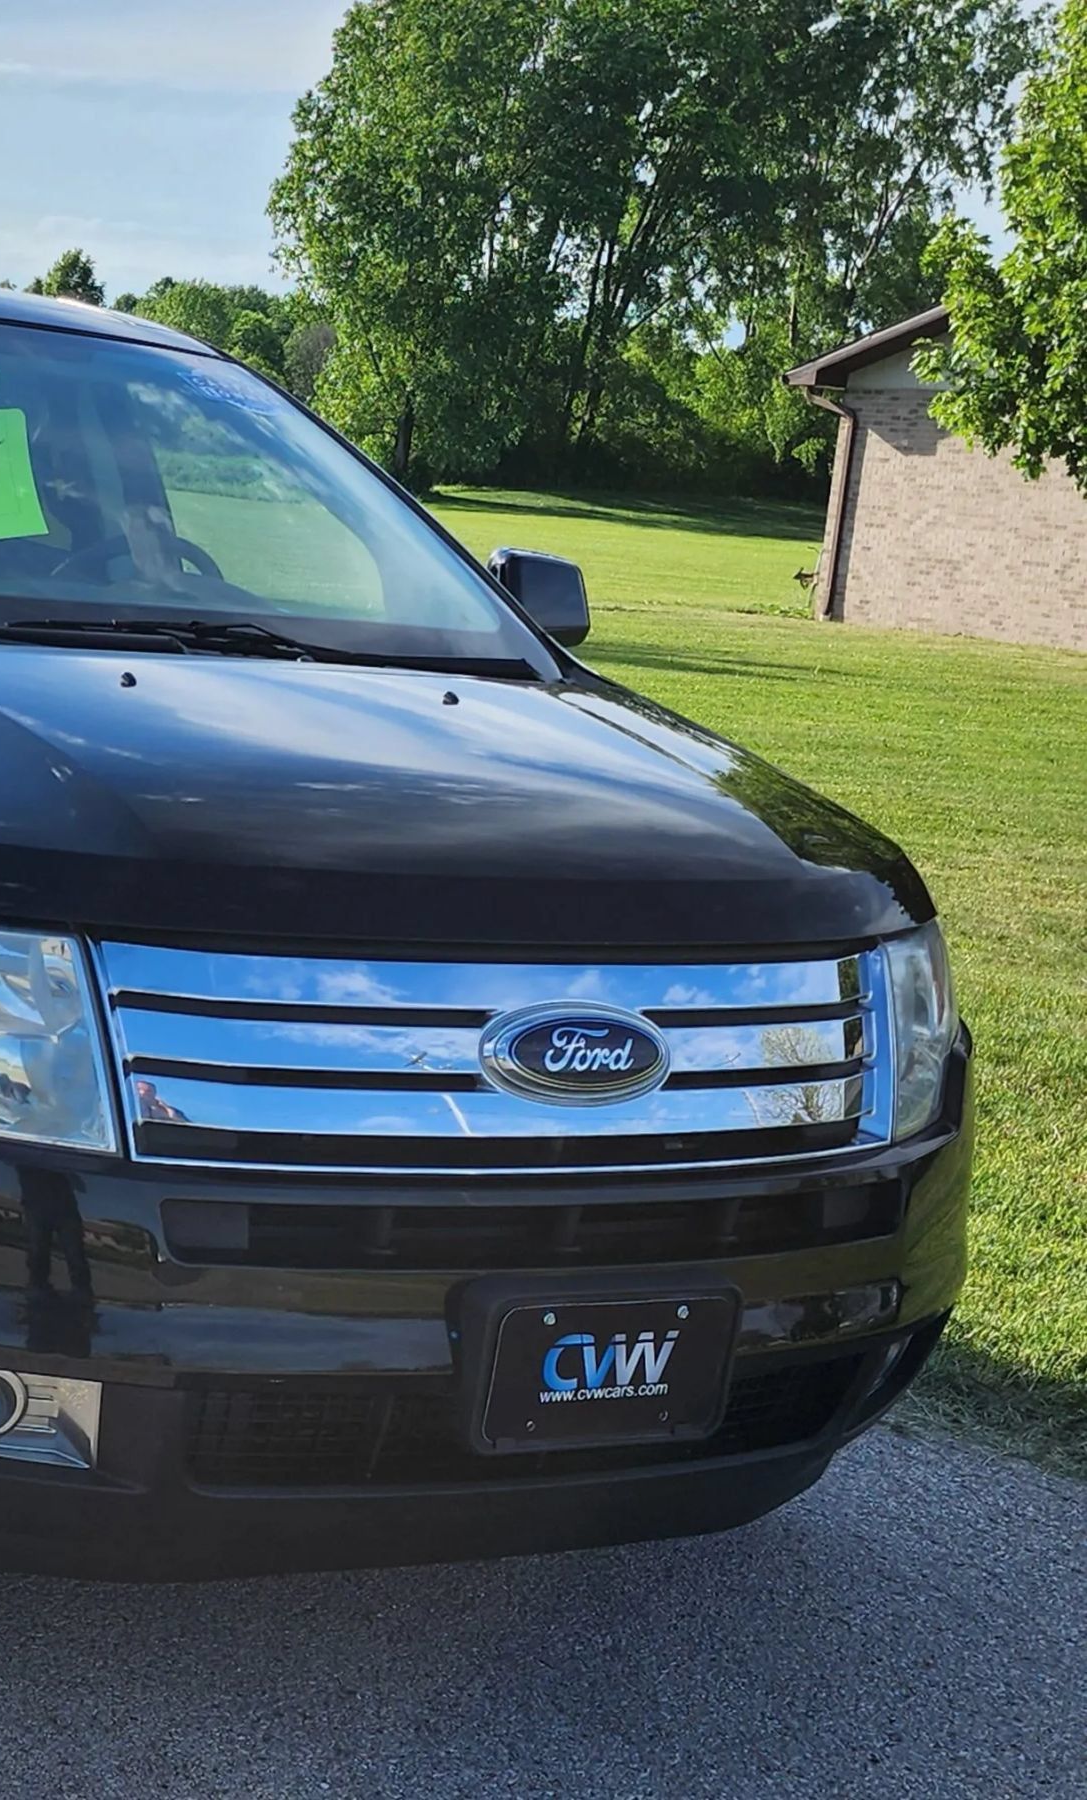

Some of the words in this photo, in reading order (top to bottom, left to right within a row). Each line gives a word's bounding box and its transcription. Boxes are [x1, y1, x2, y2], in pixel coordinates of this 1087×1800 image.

[544, 1027, 635, 1072] Ford
[543, 1330, 680, 1391] CVW
[540, 1382, 668, 1404] www.cvwcars.com
